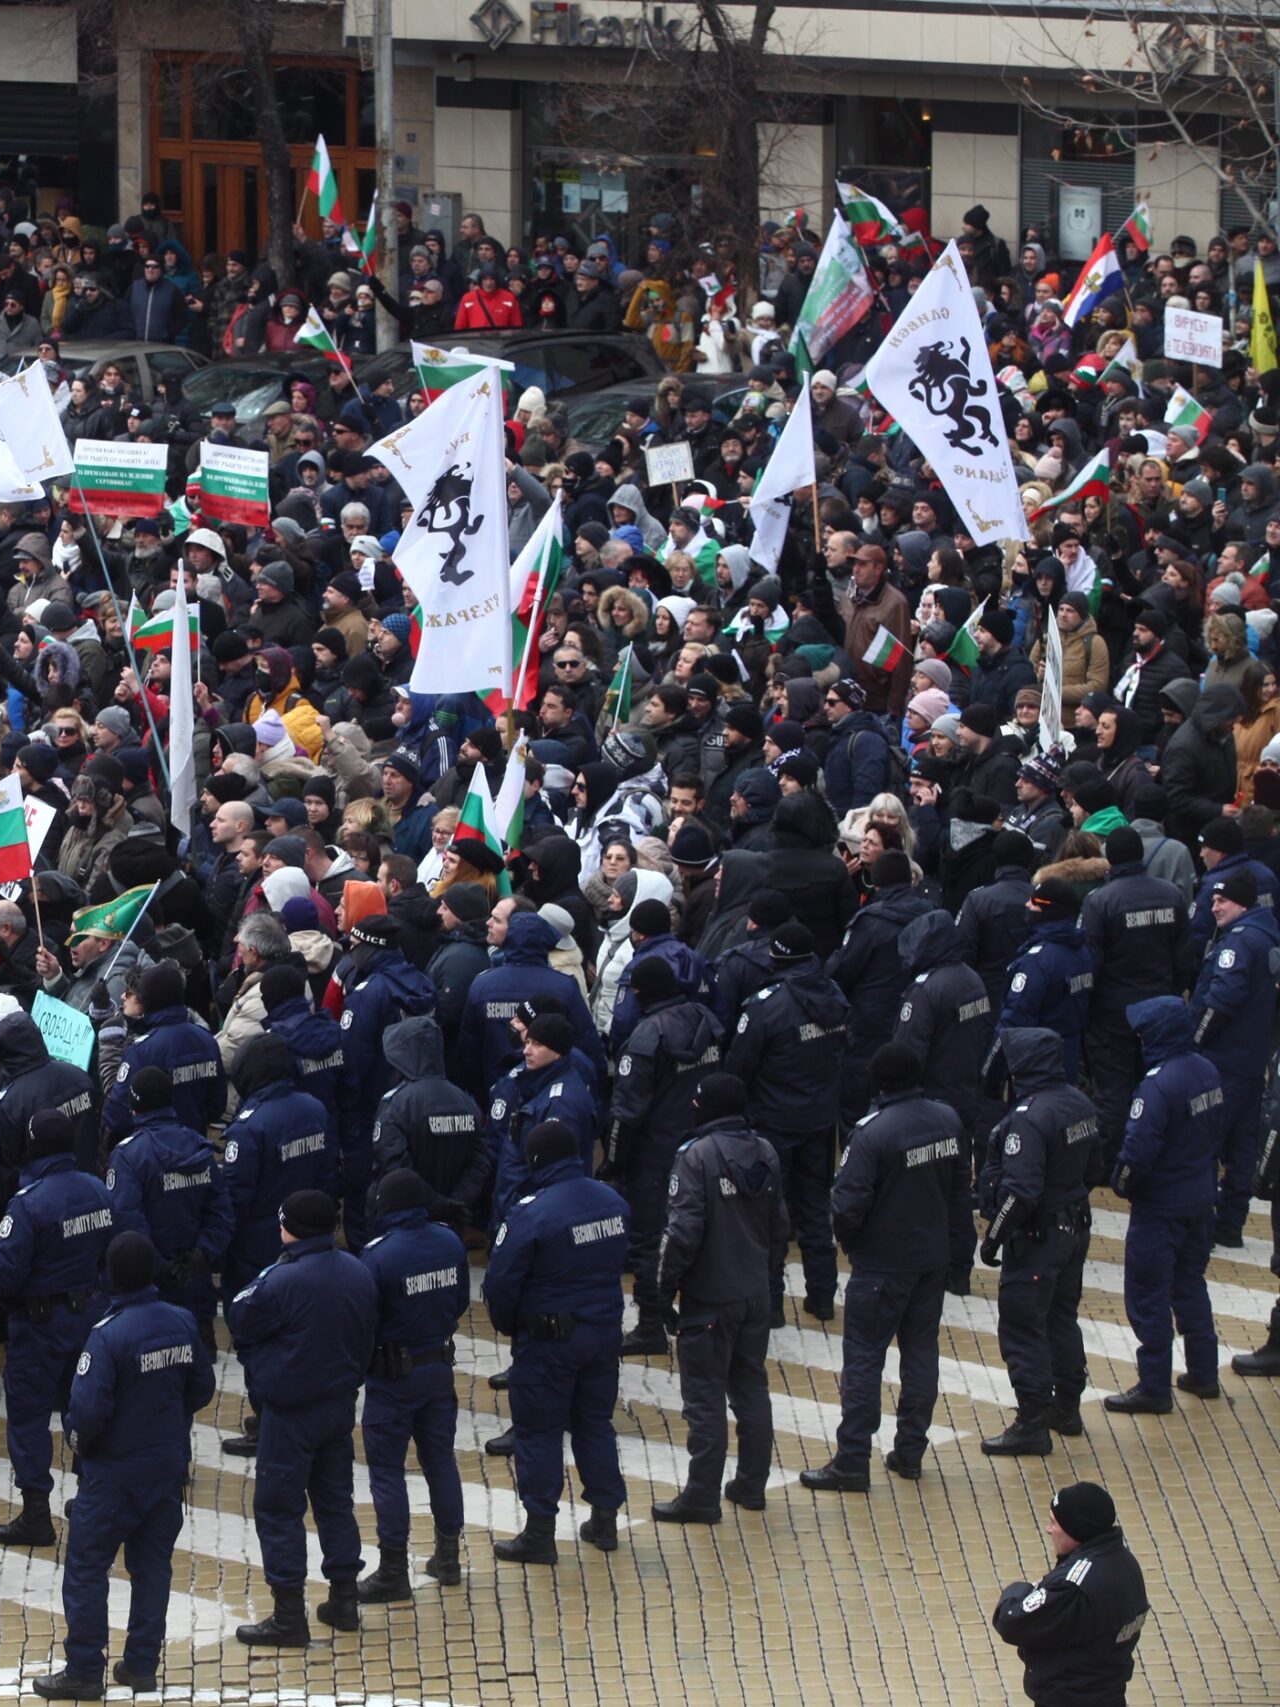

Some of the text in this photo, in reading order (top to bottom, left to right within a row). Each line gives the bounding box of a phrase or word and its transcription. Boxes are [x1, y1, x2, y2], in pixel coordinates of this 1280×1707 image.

[531, 2, 684, 49] Fibank
[351, 926, 387, 946] POLICE
[906, 1136, 959, 1168] SECURITY POLICE
[62, 1208, 112, 1239] SECURITY POLICE
[572, 1216, 625, 1246] SECURITY POLICE
[406, 1266, 458, 1296] SECURITY POLICE
[140, 1344, 193, 1373] SECURITY POLICE
